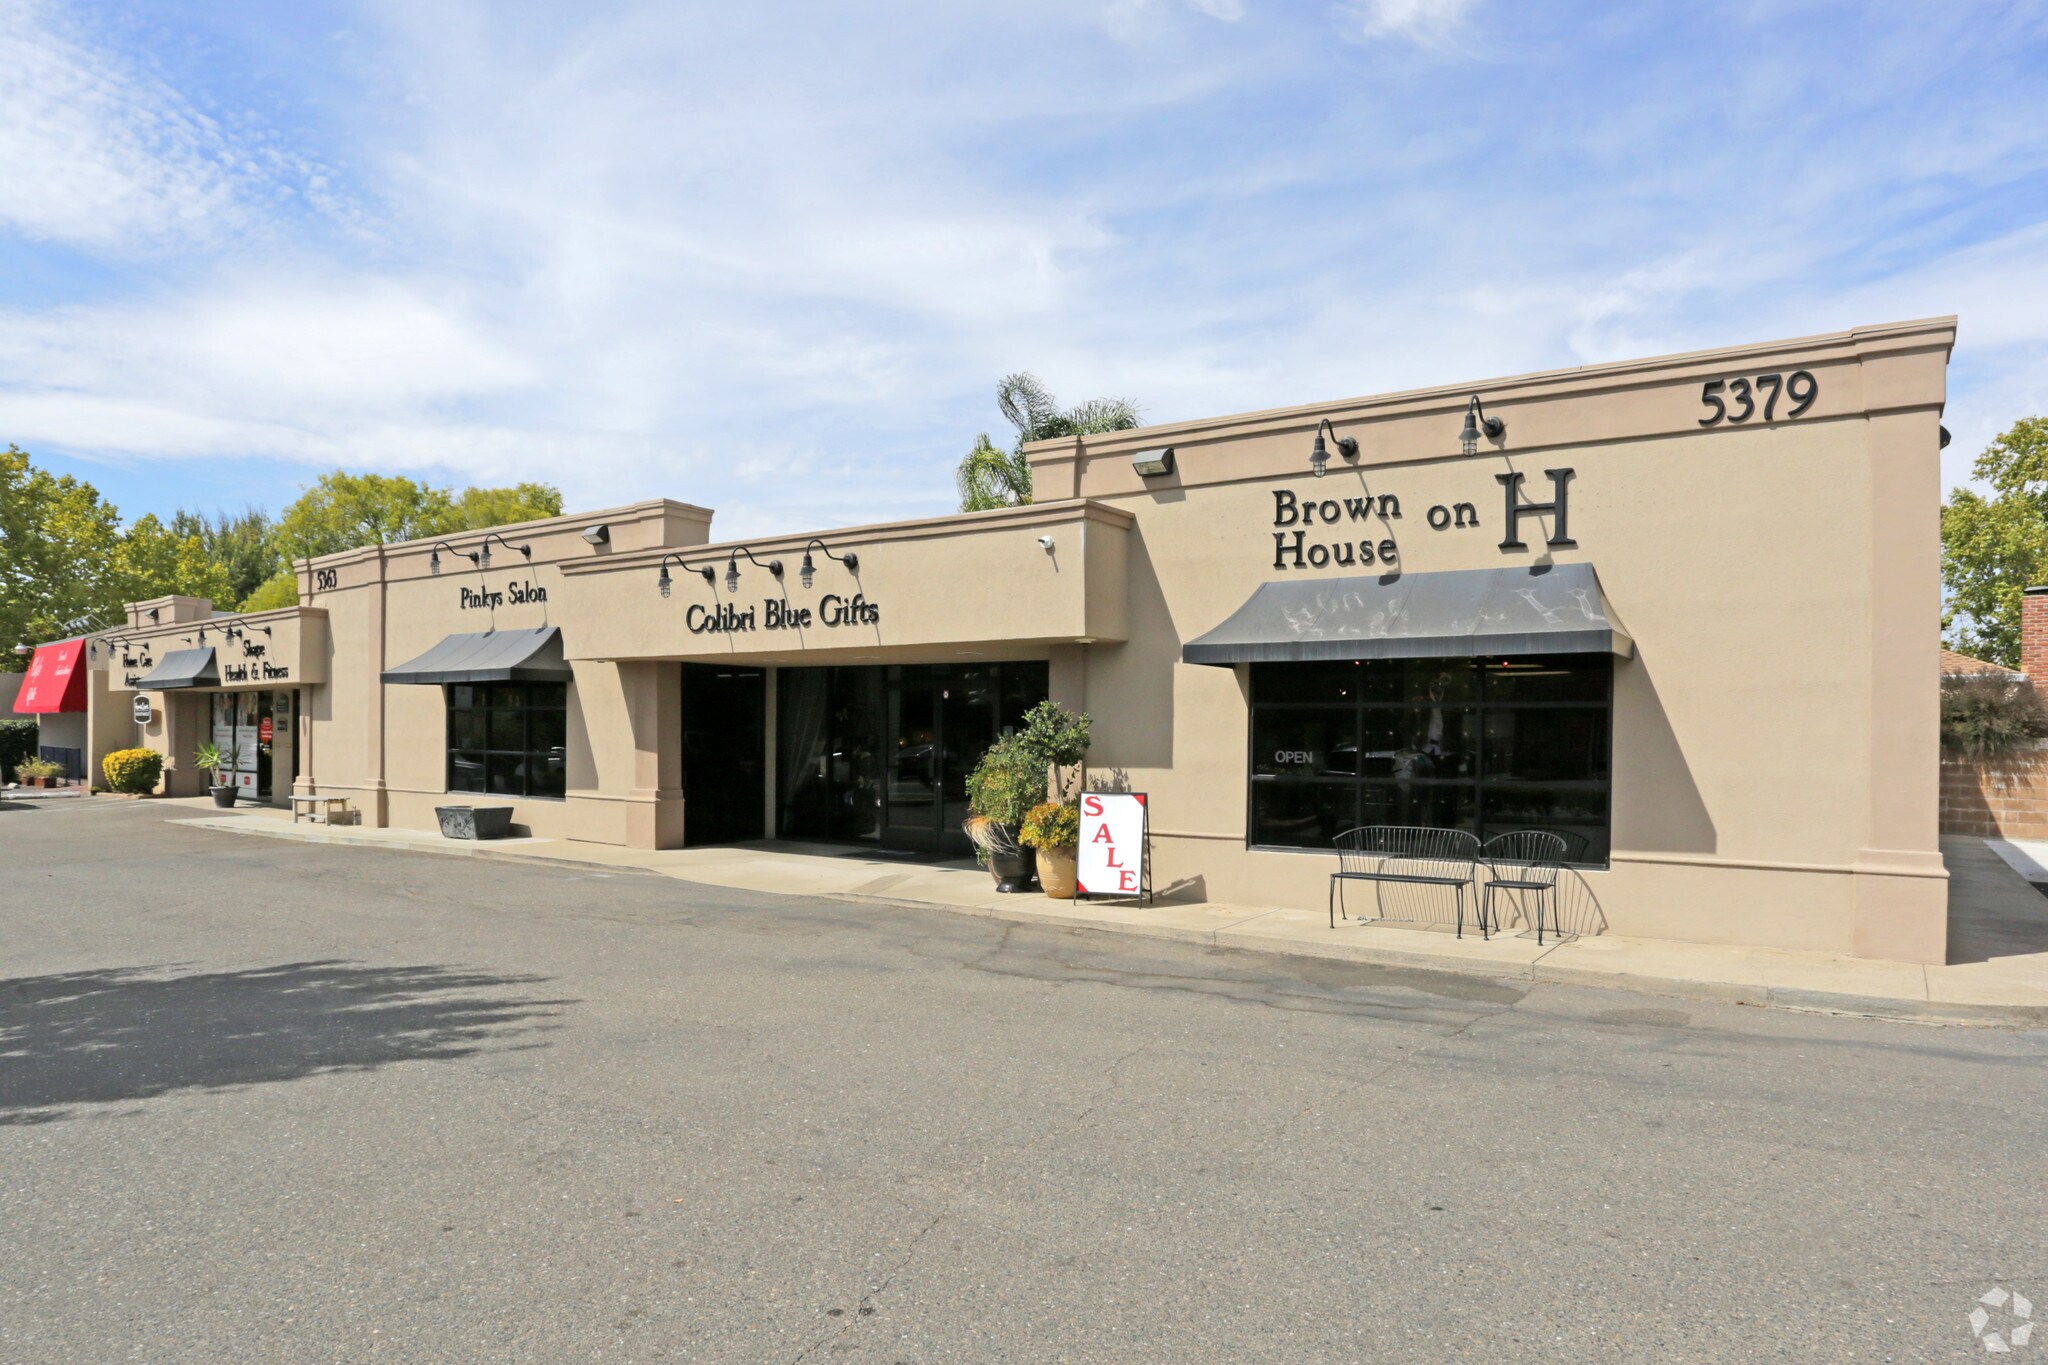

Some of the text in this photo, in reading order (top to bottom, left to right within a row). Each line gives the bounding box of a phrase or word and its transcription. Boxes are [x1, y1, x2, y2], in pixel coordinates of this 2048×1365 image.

[1698, 370, 1817, 425] 5379
[1272, 467, 1577, 549] Brown on H
[1273, 530, 1397, 568] House
[460, 580, 547, 611] Pinkys Salon
[686, 593, 880, 634] Colibri Blue Gifts
[224, 661, 289, 682] Health & Fitness
[1275, 750, 1313, 764] OPEN
[1083, 795, 1139, 892] SALE
